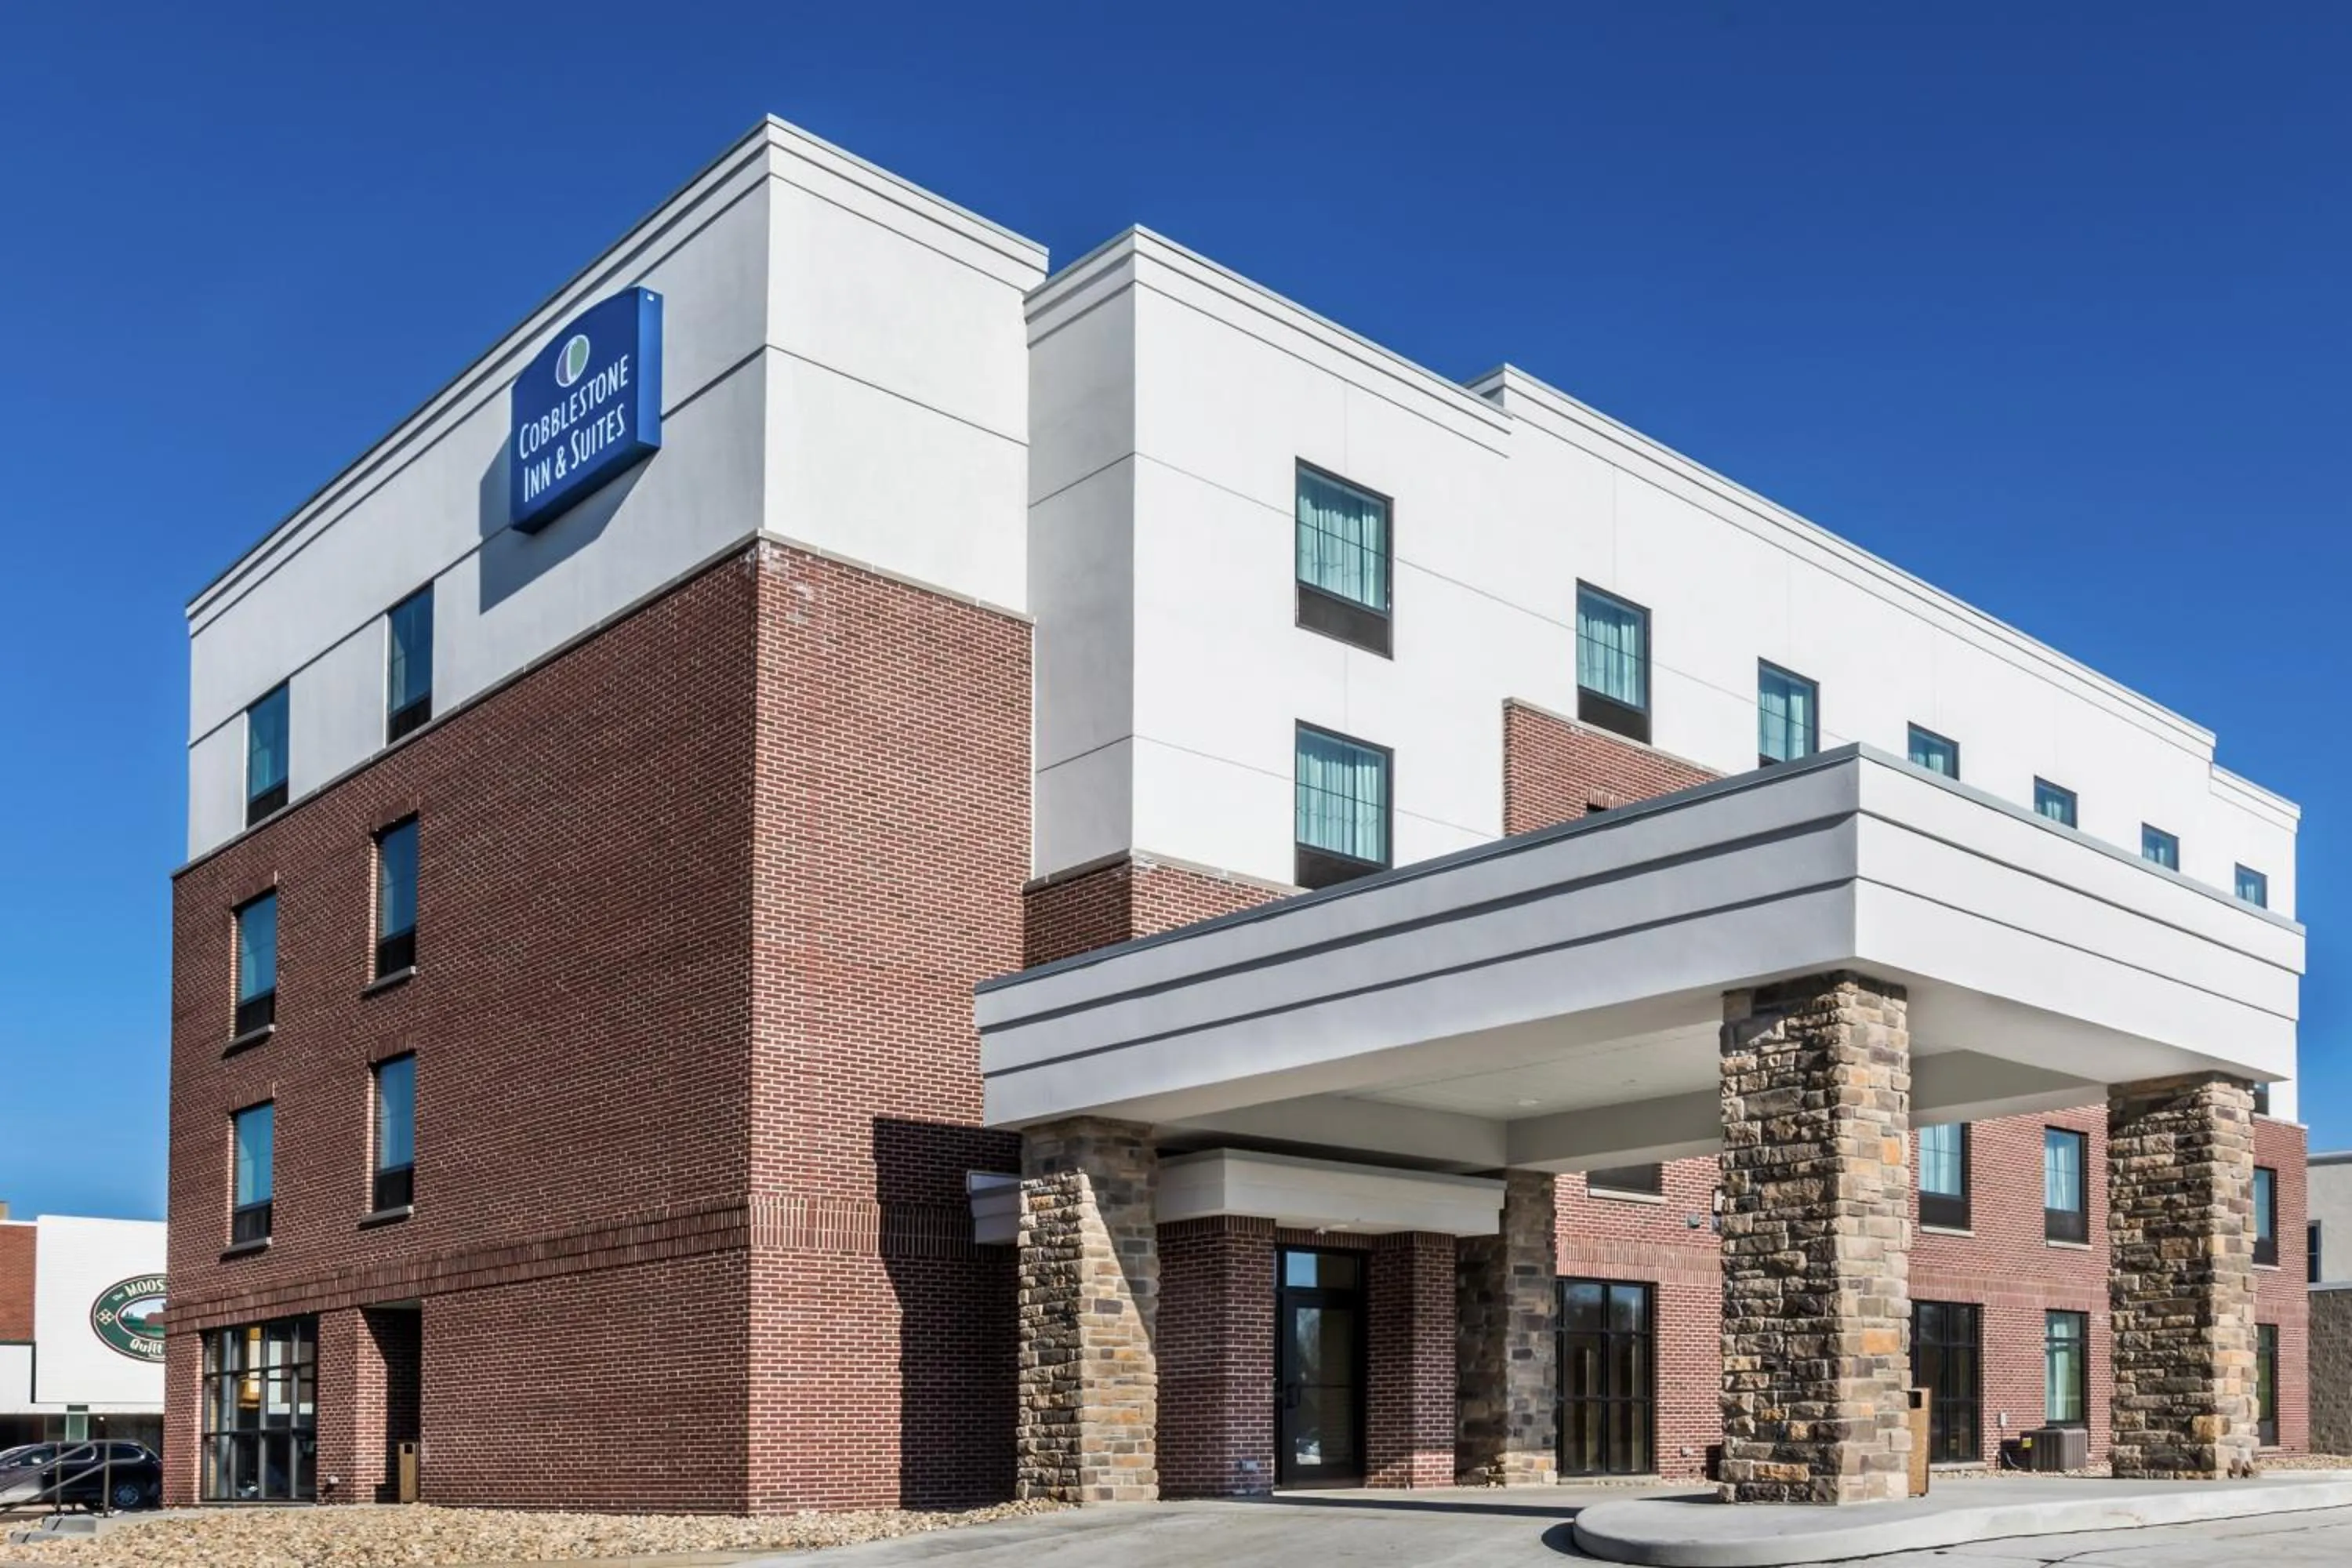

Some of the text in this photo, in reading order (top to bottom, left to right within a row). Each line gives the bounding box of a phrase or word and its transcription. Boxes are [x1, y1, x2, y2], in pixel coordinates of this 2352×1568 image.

[519, 354, 629, 459] COBBLESTONE
[524, 403, 626, 502] INN & SUITES
